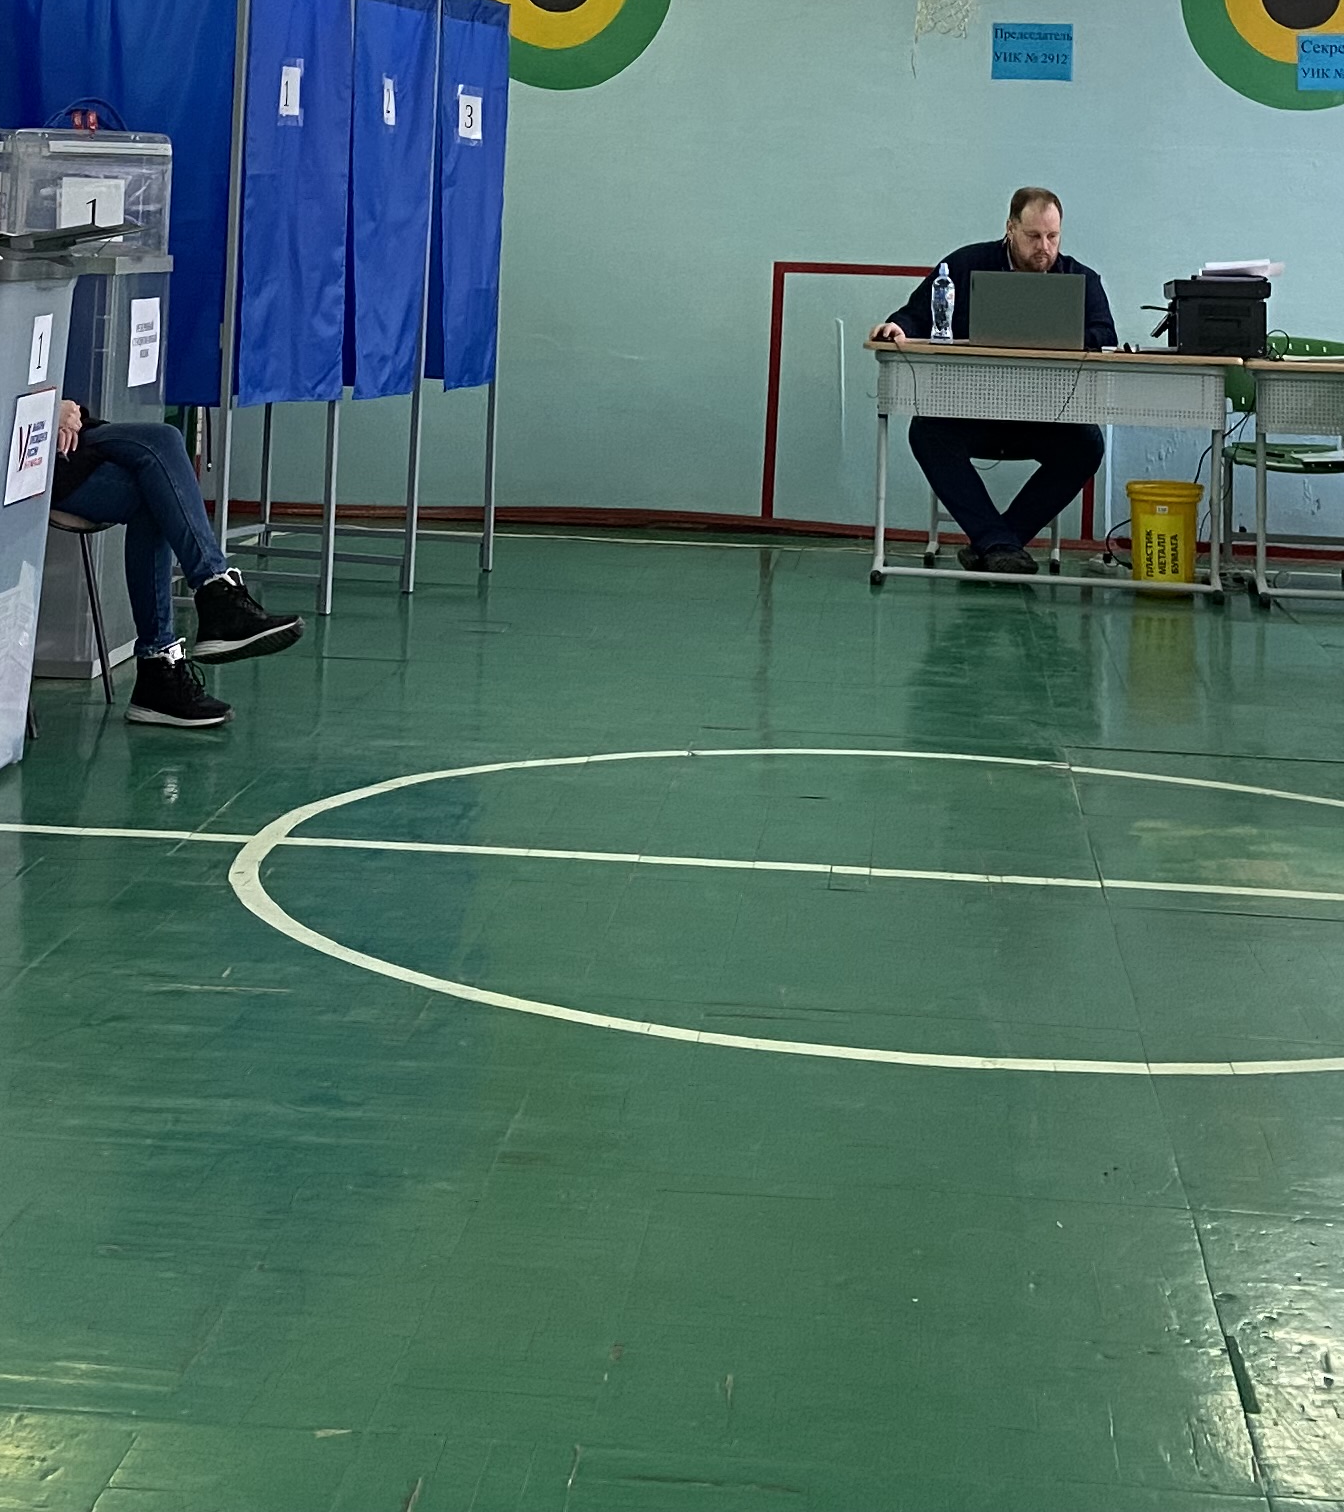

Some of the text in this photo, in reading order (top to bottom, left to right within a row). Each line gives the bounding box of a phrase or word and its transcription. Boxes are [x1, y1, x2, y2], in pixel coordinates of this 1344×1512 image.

[994, 52, 1022, 64] УИК
[1041, 53, 1068, 65] 2912
[1300, 67, 1331, 79] УИК
[282, 80, 290, 107] 1
[385, 88, 391, 114] 2
[464, 104, 474, 129] 3
[36, 331, 44, 370] 1
[1145, 529, 1154, 577] ПЛАСТИК
[1157, 533, 1167, 575] МЕТАЛЛ
[1170, 533, 1179, 574] БУМАГА
